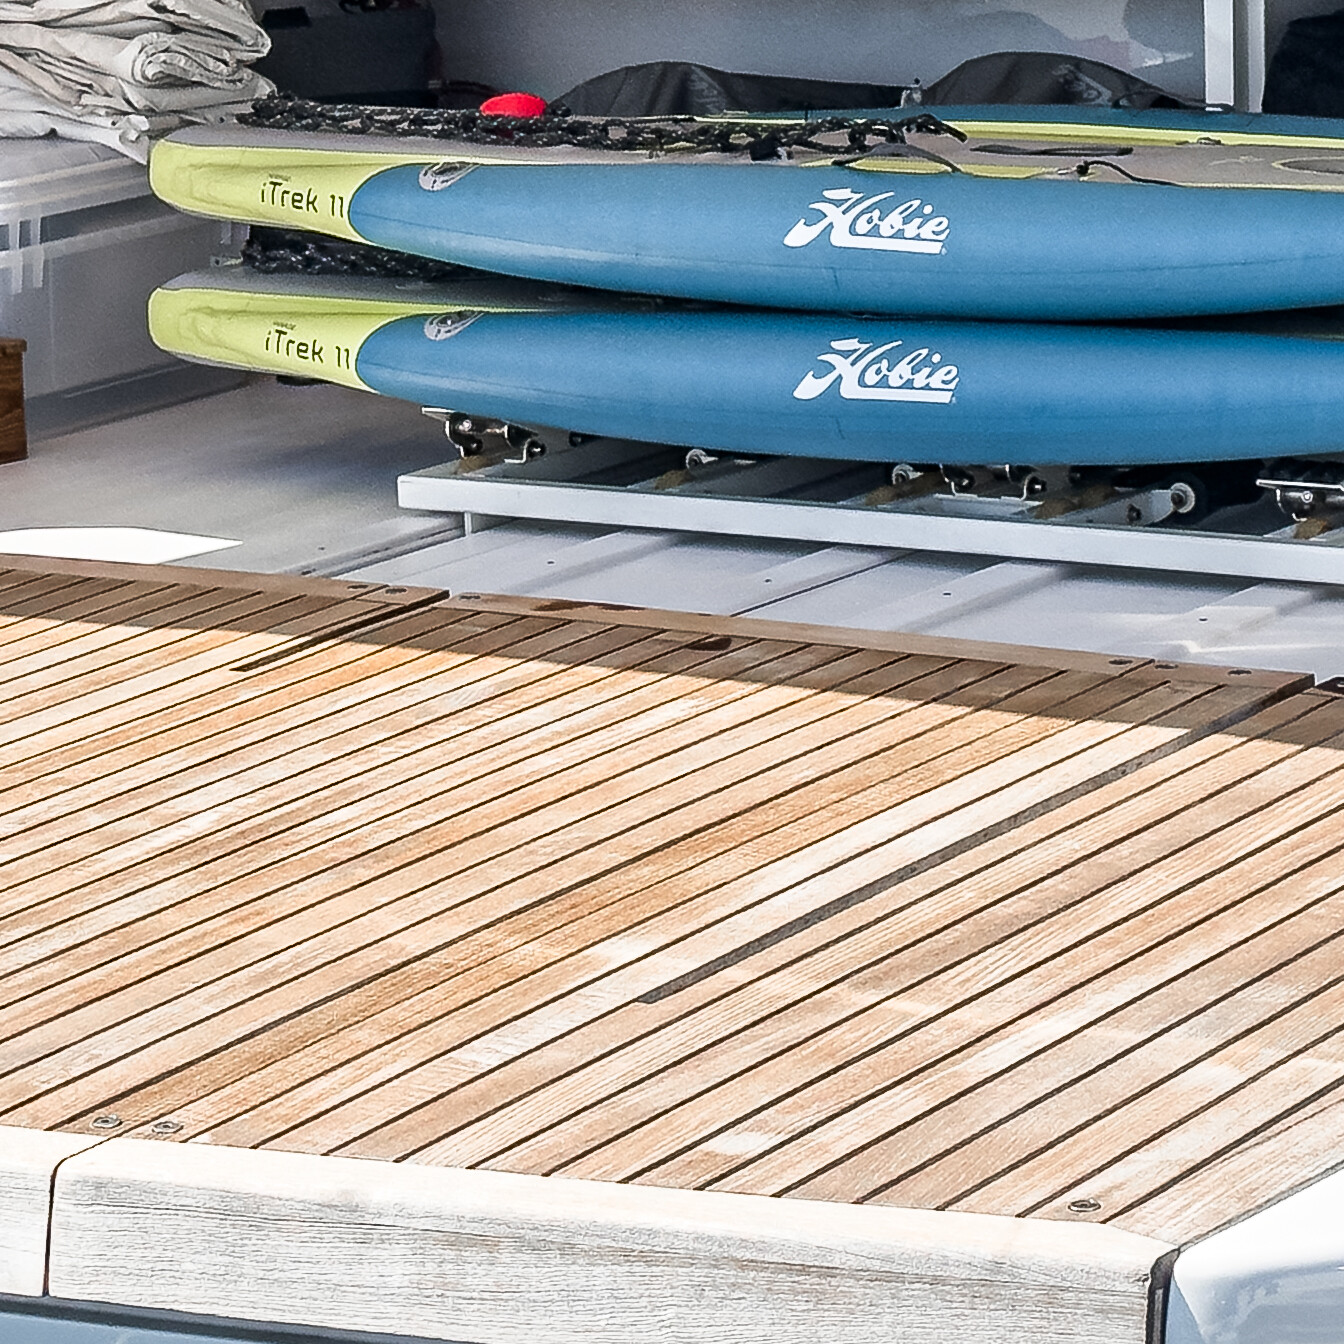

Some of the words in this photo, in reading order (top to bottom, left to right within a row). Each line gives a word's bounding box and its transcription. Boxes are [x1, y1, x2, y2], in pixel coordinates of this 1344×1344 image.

[261, 181, 318, 213] iTrek
[330, 194, 344, 218] 11
[783, 188, 950, 255] Hobie
[265, 329, 324, 364] iTrek
[336, 345, 350, 369] 11
[792, 338, 960, 404] Hobie
